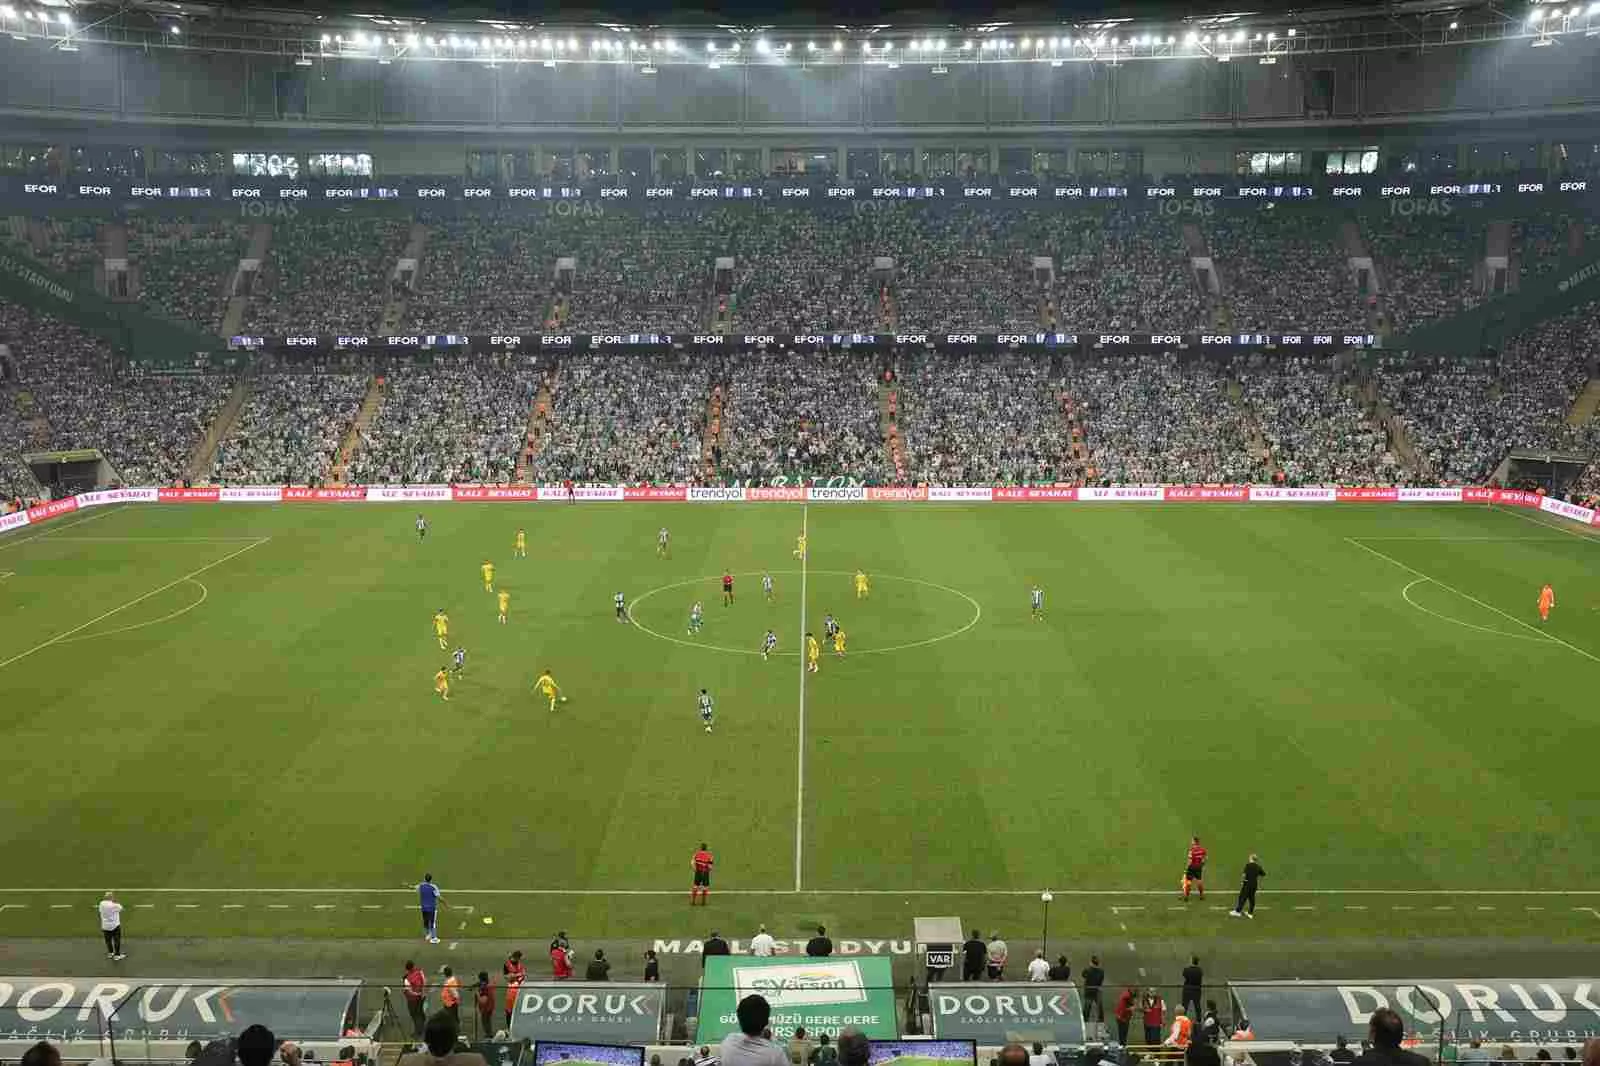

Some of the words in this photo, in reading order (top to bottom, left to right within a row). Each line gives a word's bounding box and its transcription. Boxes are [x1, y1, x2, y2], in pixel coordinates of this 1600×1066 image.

[25, 185, 56, 193] EFOR
[80, 186, 110, 194] EFOR
[1382, 187, 1410, 195] EFOR
[1431, 186, 1459, 195] EFOR
[1519, 184, 1543, 192] EFOR
[1560, 182, 1586, 191] EFOR
[131, 188, 161, 196] EFOR
[232, 189, 260, 197] EFOR
[280, 189, 307, 197] EFOR
[326, 189, 352, 197] EFOR
[418, 189, 445, 197] EFOR
[464, 189, 491, 197] EFOR
[509, 189, 536, 197] EFOR
[601, 188, 627, 197] EFOR
[647, 188, 674, 196] EFOR
[691, 188, 717, 197] EFOR
[783, 188, 809, 196] EFOR
[828, 188, 855, 196] EFOR
[873, 188, 899, 196] EFOR
[965, 188, 991, 196] EFOR
[1010, 188, 1037, 196] EFOR
[1056, 188, 1082, 196] EFOR
[1148, 188, 1174, 196] EFOR
[1194, 188, 1221, 196] EFOR
[1240, 188, 1266, 196] EFOR
[1333, 188, 1361, 196] EFOR
[287, 336, 316, 345] EFOR
[338, 335, 368, 345] EFOR
[389, 335, 418, 345] EFOR
[491, 335, 520, 344] EFOR
[542, 335, 571, 345] EFOR
[592, 335, 621, 345] EFOR
[694, 335, 725, 344] EFOR
[744, 335, 774, 345] EFOR
[795, 335, 824, 345] EFOR
[897, 335, 926, 345] EFOR
[948, 335, 977, 345] EFOR
[998, 335, 1027, 345] EFOR
[1100, 335, 1129, 345] EFOR
[1152, 335, 1181, 345] EFOR
[1202, 335, 1231, 345] EFOR
[1283, 335, 1301, 345] EFOR
[1314, 335, 1332, 345] EFOR
[1344, 335, 1362, 345] EFOR
[691, 487, 743, 499] trendyol
[752, 487, 803, 499] trendyol
[812, 487, 864, 499] trendyol
[873, 487, 925, 499] trendyol
[930, 954, 951, 963] VAR
[0, 981, 237, 1020] ORUK
[521, 993, 650, 1014] DORUK
[939, 993, 1070, 1015] DORUK
[806, 1014, 840, 1024] GERE
[844, 1014, 880, 1024] GERE
